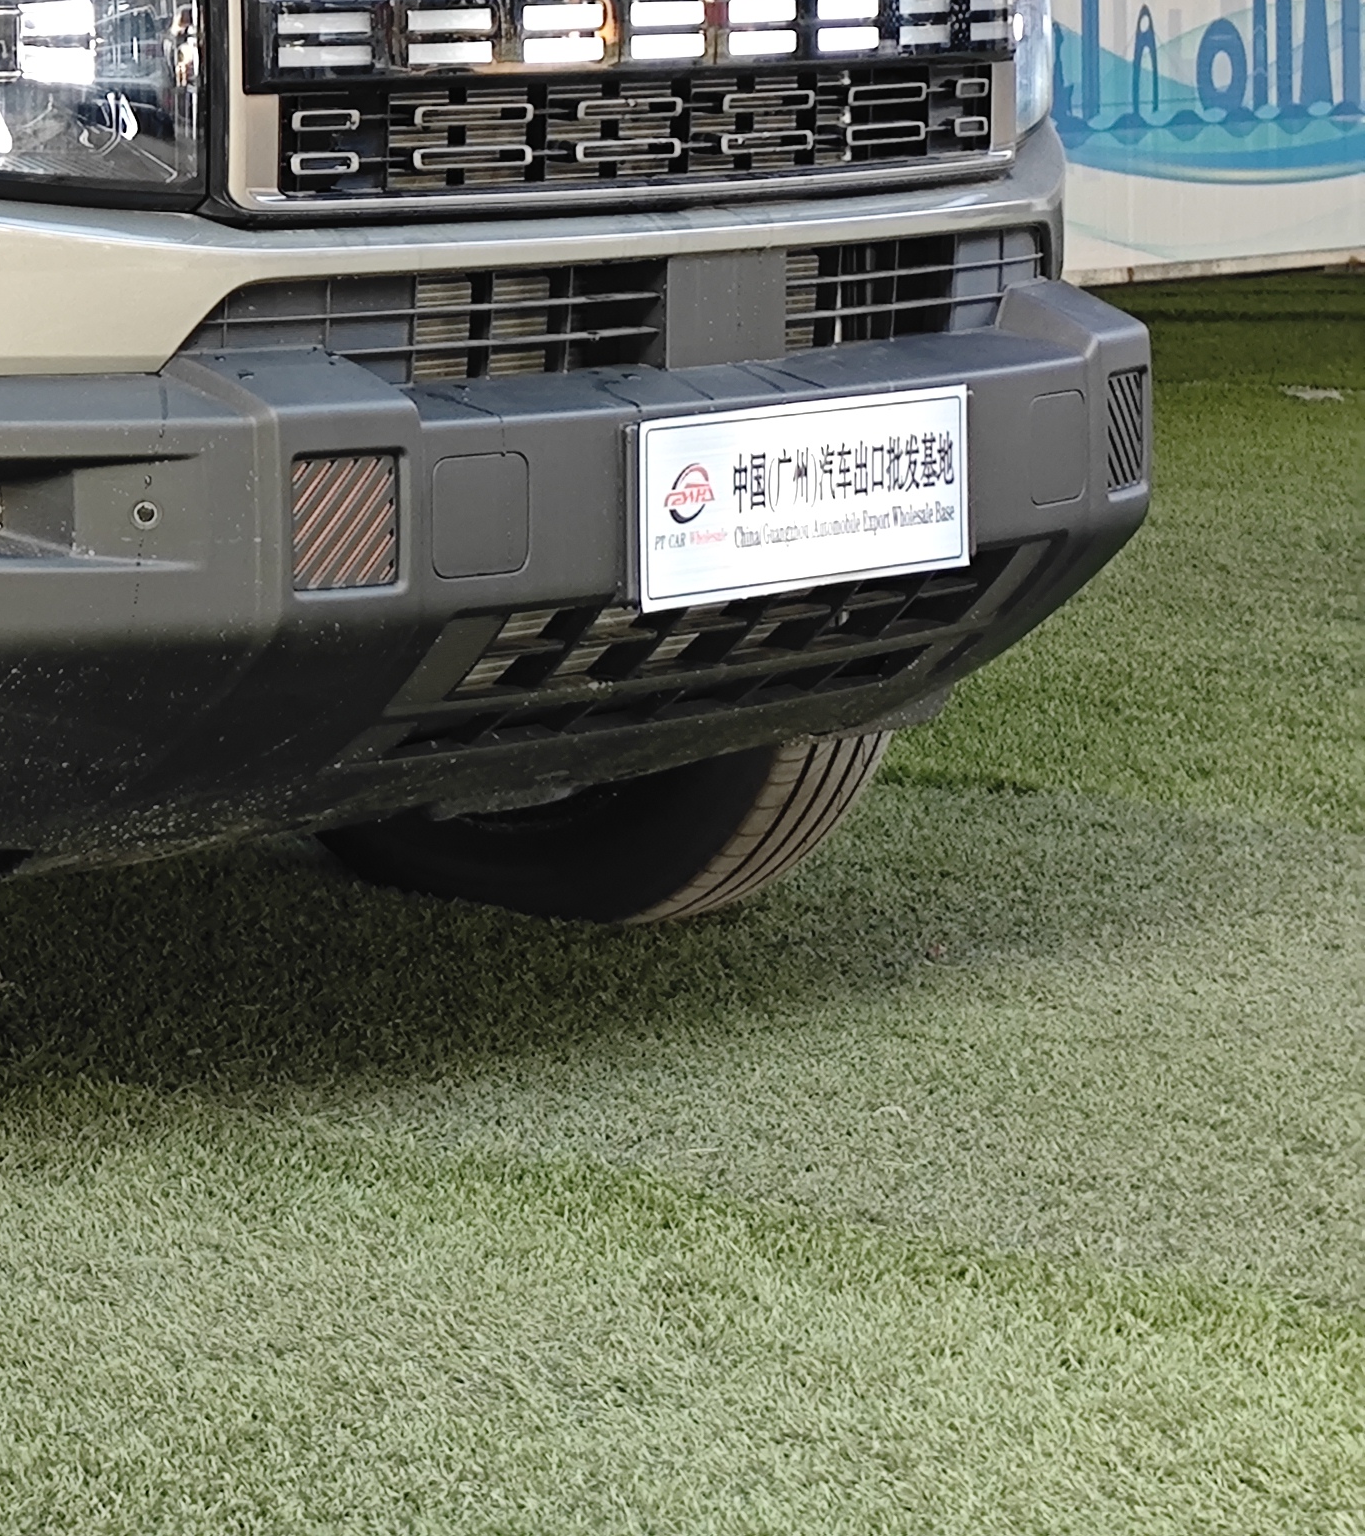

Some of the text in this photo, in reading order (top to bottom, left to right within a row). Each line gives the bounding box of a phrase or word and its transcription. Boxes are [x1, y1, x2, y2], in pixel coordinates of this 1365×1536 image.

[732, 429, 955, 514] 中国(广州)汽车出口批发基地
[934, 500, 955, 523] Base
